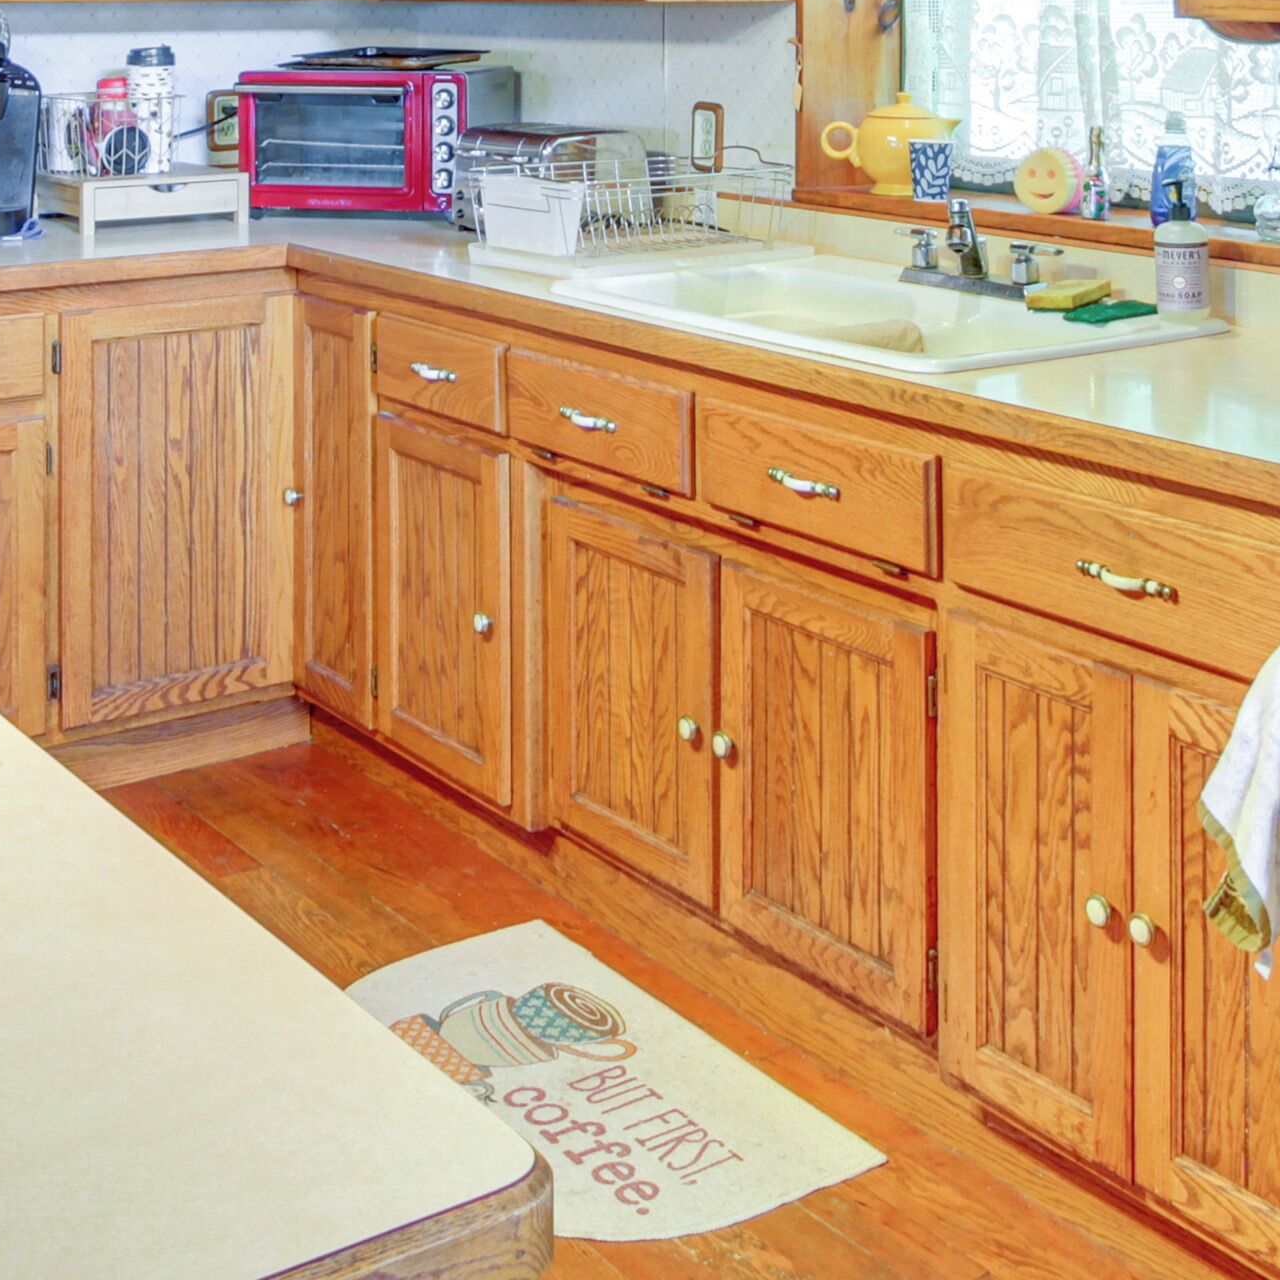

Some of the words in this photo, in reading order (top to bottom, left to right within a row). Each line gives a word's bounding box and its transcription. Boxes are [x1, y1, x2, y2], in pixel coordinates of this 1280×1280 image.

[1163, 250, 1201, 260] MEYER'S
[1177, 291, 1203, 299] SOAP
[504, 1085, 661, 1216] coffee.
[567, 1065, 663, 1116] BUT
[622, 1108, 744, 1186] FIRST,
